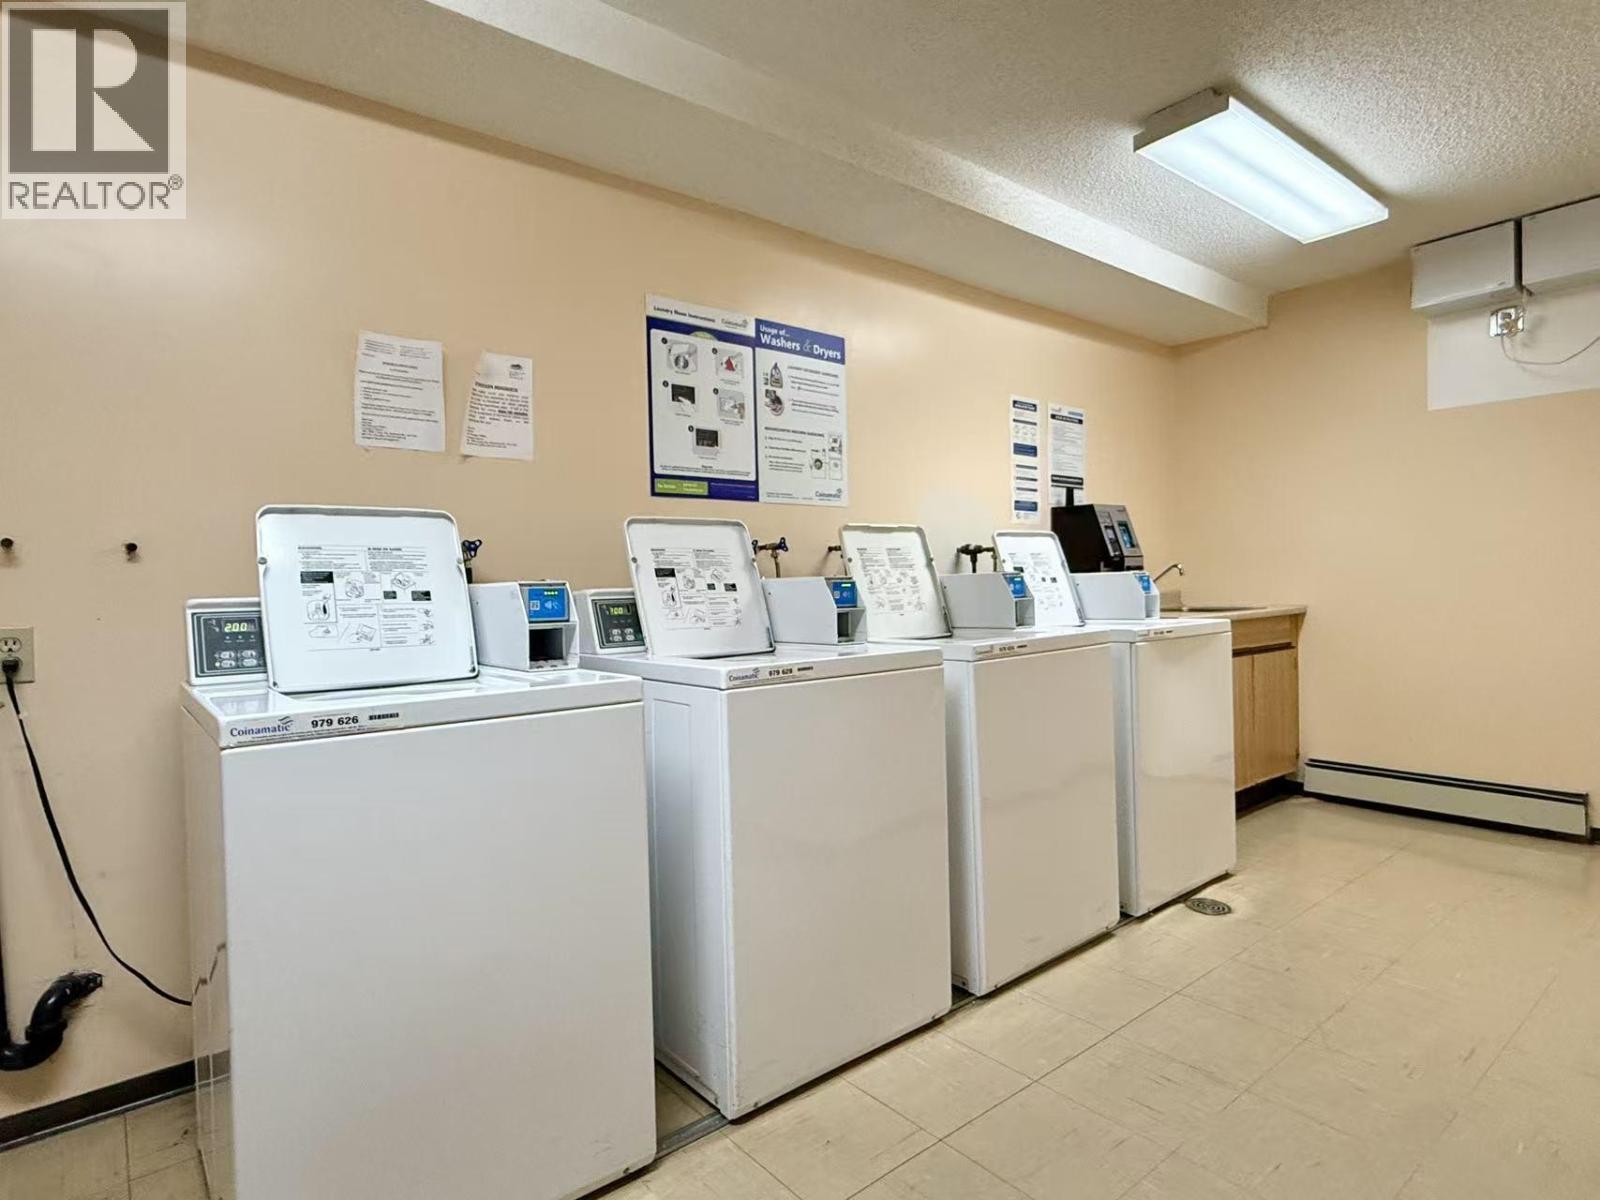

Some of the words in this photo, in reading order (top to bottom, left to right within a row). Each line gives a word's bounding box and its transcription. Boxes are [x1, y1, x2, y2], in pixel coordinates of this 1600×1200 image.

[759, 323, 778, 336] Usage
[760, 332, 801, 352] Washers
[802, 339, 813, 353] &
[812, 344, 842, 360] Dryers
[229, 722, 293, 738] Coinamatic
[311, 717, 333, 729] 979
[337, 715, 359, 726] 626
